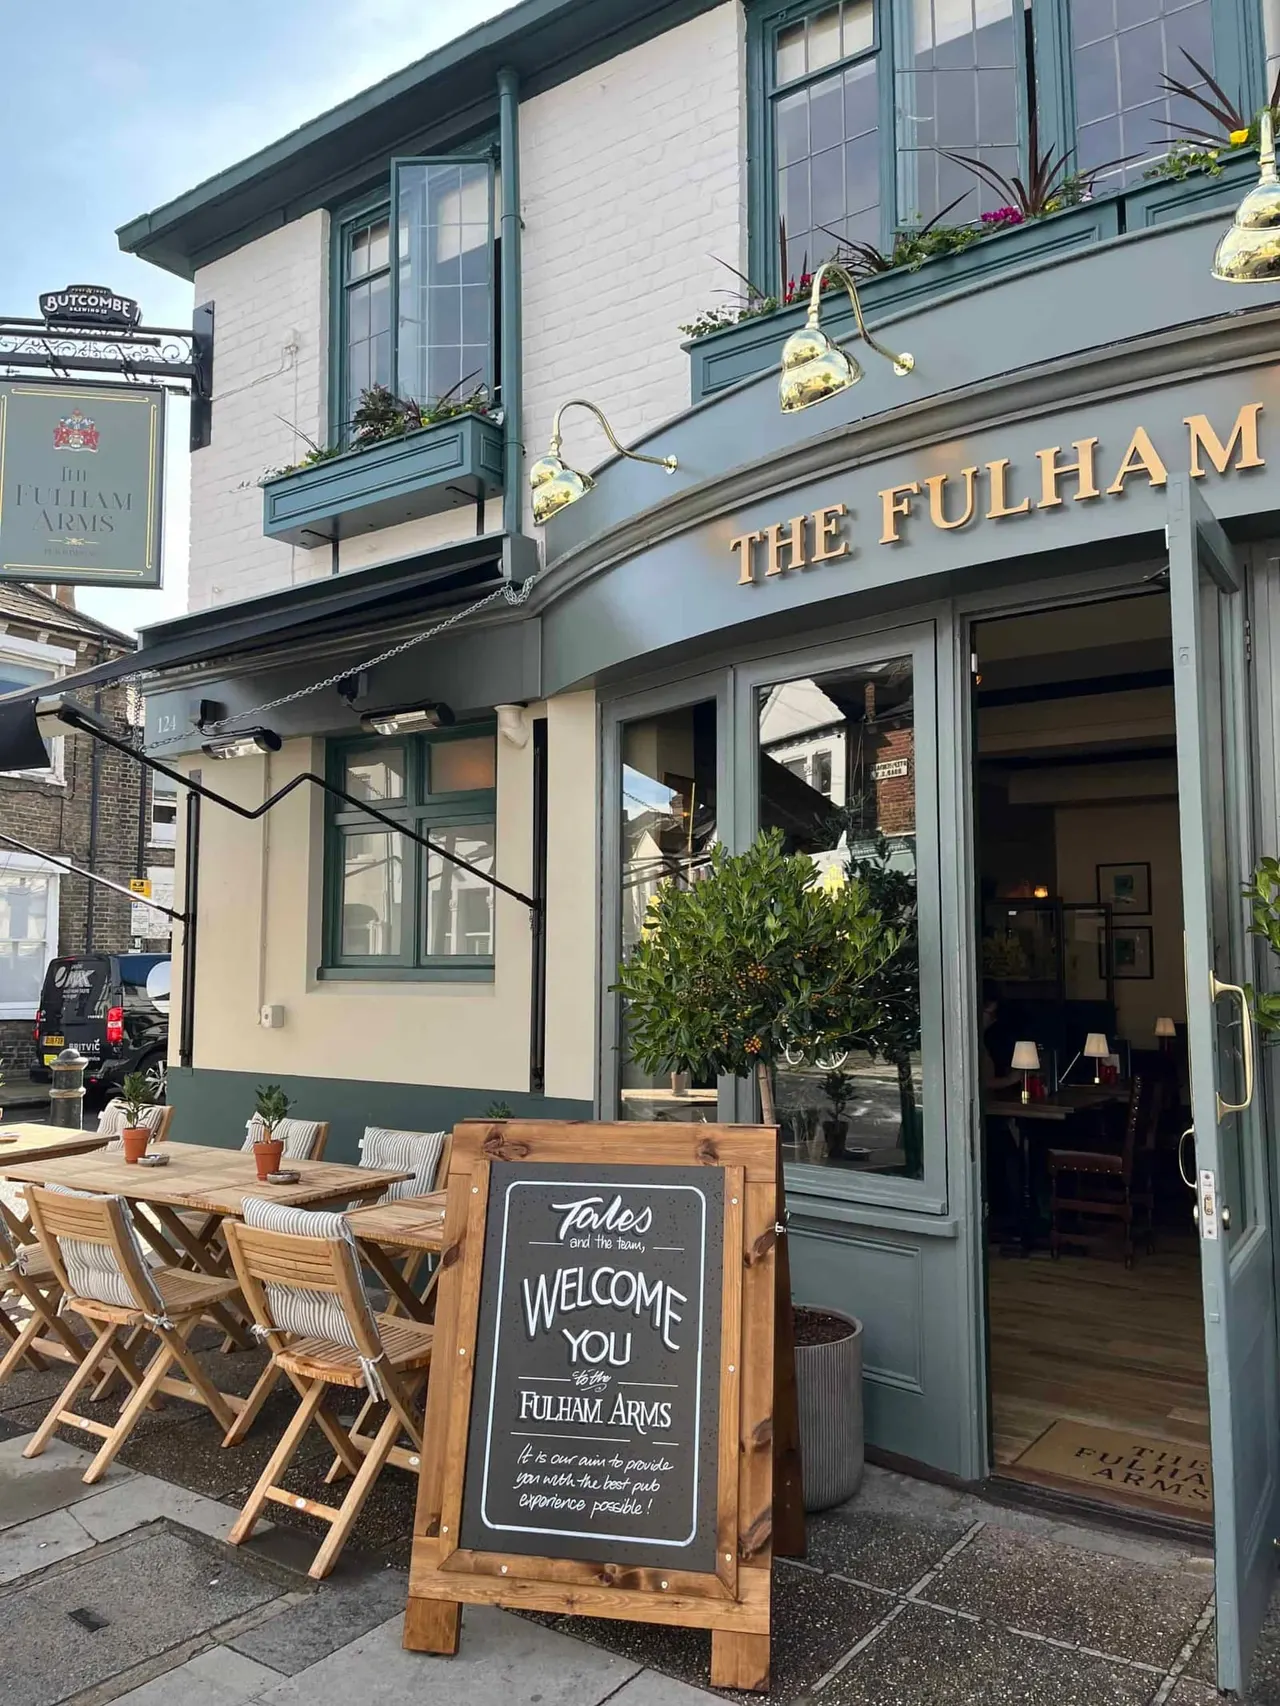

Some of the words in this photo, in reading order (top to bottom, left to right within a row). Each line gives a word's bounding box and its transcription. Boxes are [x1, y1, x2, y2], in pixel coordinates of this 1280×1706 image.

[44, 294, 131, 318] BUTCOMBE
[16, 484, 132, 510] FULHAM
[729, 503, 850, 586] THE
[877, 401, 1266, 545] FULHAM
[32, 508, 114, 532] ARMS
[158, 715, 176, 733] 124
[552, 1195, 652, 1240] Tales
[569, 1234, 591, 1249] and
[594, 1234, 613, 1249] the
[616, 1236, 646, 1253] team,
[523, 1266, 687, 1350] WELCOME
[562, 1328, 632, 1366] YOU
[519, 1391, 603, 1423] FULHAM
[607, 1392, 672, 1435] ARMS
[517, 1442, 533, 1464] It
[535, 1450, 547, 1464] is
[550, 1453, 578, 1465] our
[578, 1454, 606, 1466] aim
[608, 1453, 624, 1468] to
[624, 1457, 675, 1474] provide
[1074, 1447, 1206, 1485] FULHA
[1132, 1445, 1209, 1471] THE
[513, 1471, 540, 1489] you
[543, 1472, 576, 1487] with
[577, 1473, 601, 1490] the
[603, 1474, 631, 1491] best
[631, 1478, 661, 1495] pub
[1092, 1468, 1211, 1499] ARMS
[519, 1493, 587, 1511] experience
